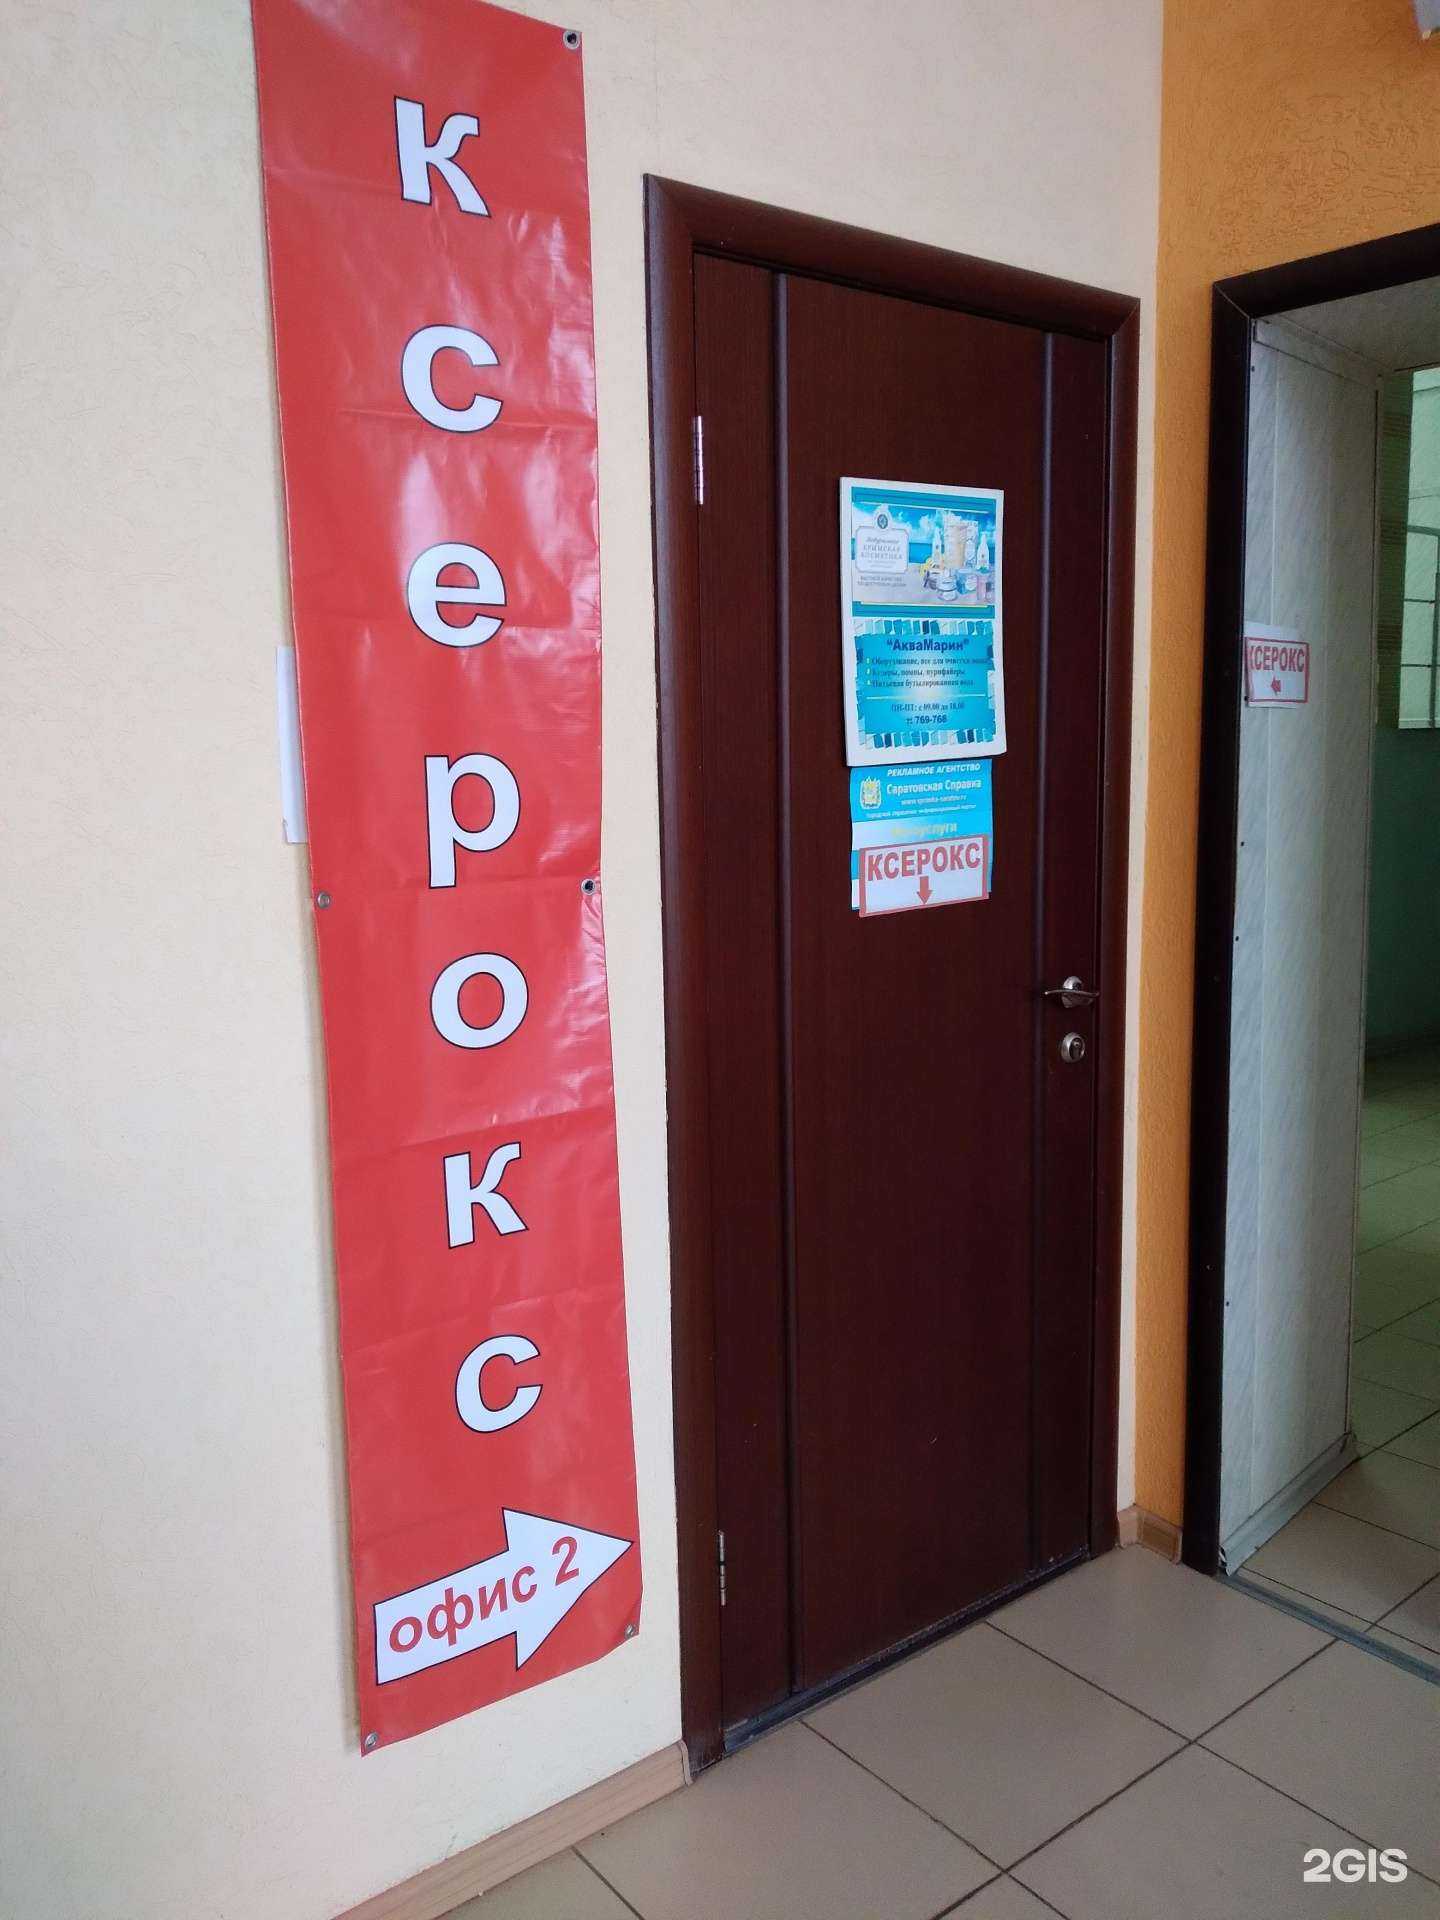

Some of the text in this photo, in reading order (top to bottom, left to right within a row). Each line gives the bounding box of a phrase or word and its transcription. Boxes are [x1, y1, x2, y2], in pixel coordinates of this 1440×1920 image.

[394, 96, 543, 1434] ксерокс
[887, 763, 981, 777] РЕКЛАМНОЕ АГЕНТСТВО
[886, 779, 982, 797] Саратовская Справка
[867, 842, 981, 881] КСЕРОКС
[389, 1536, 580, 1653] офис 2
